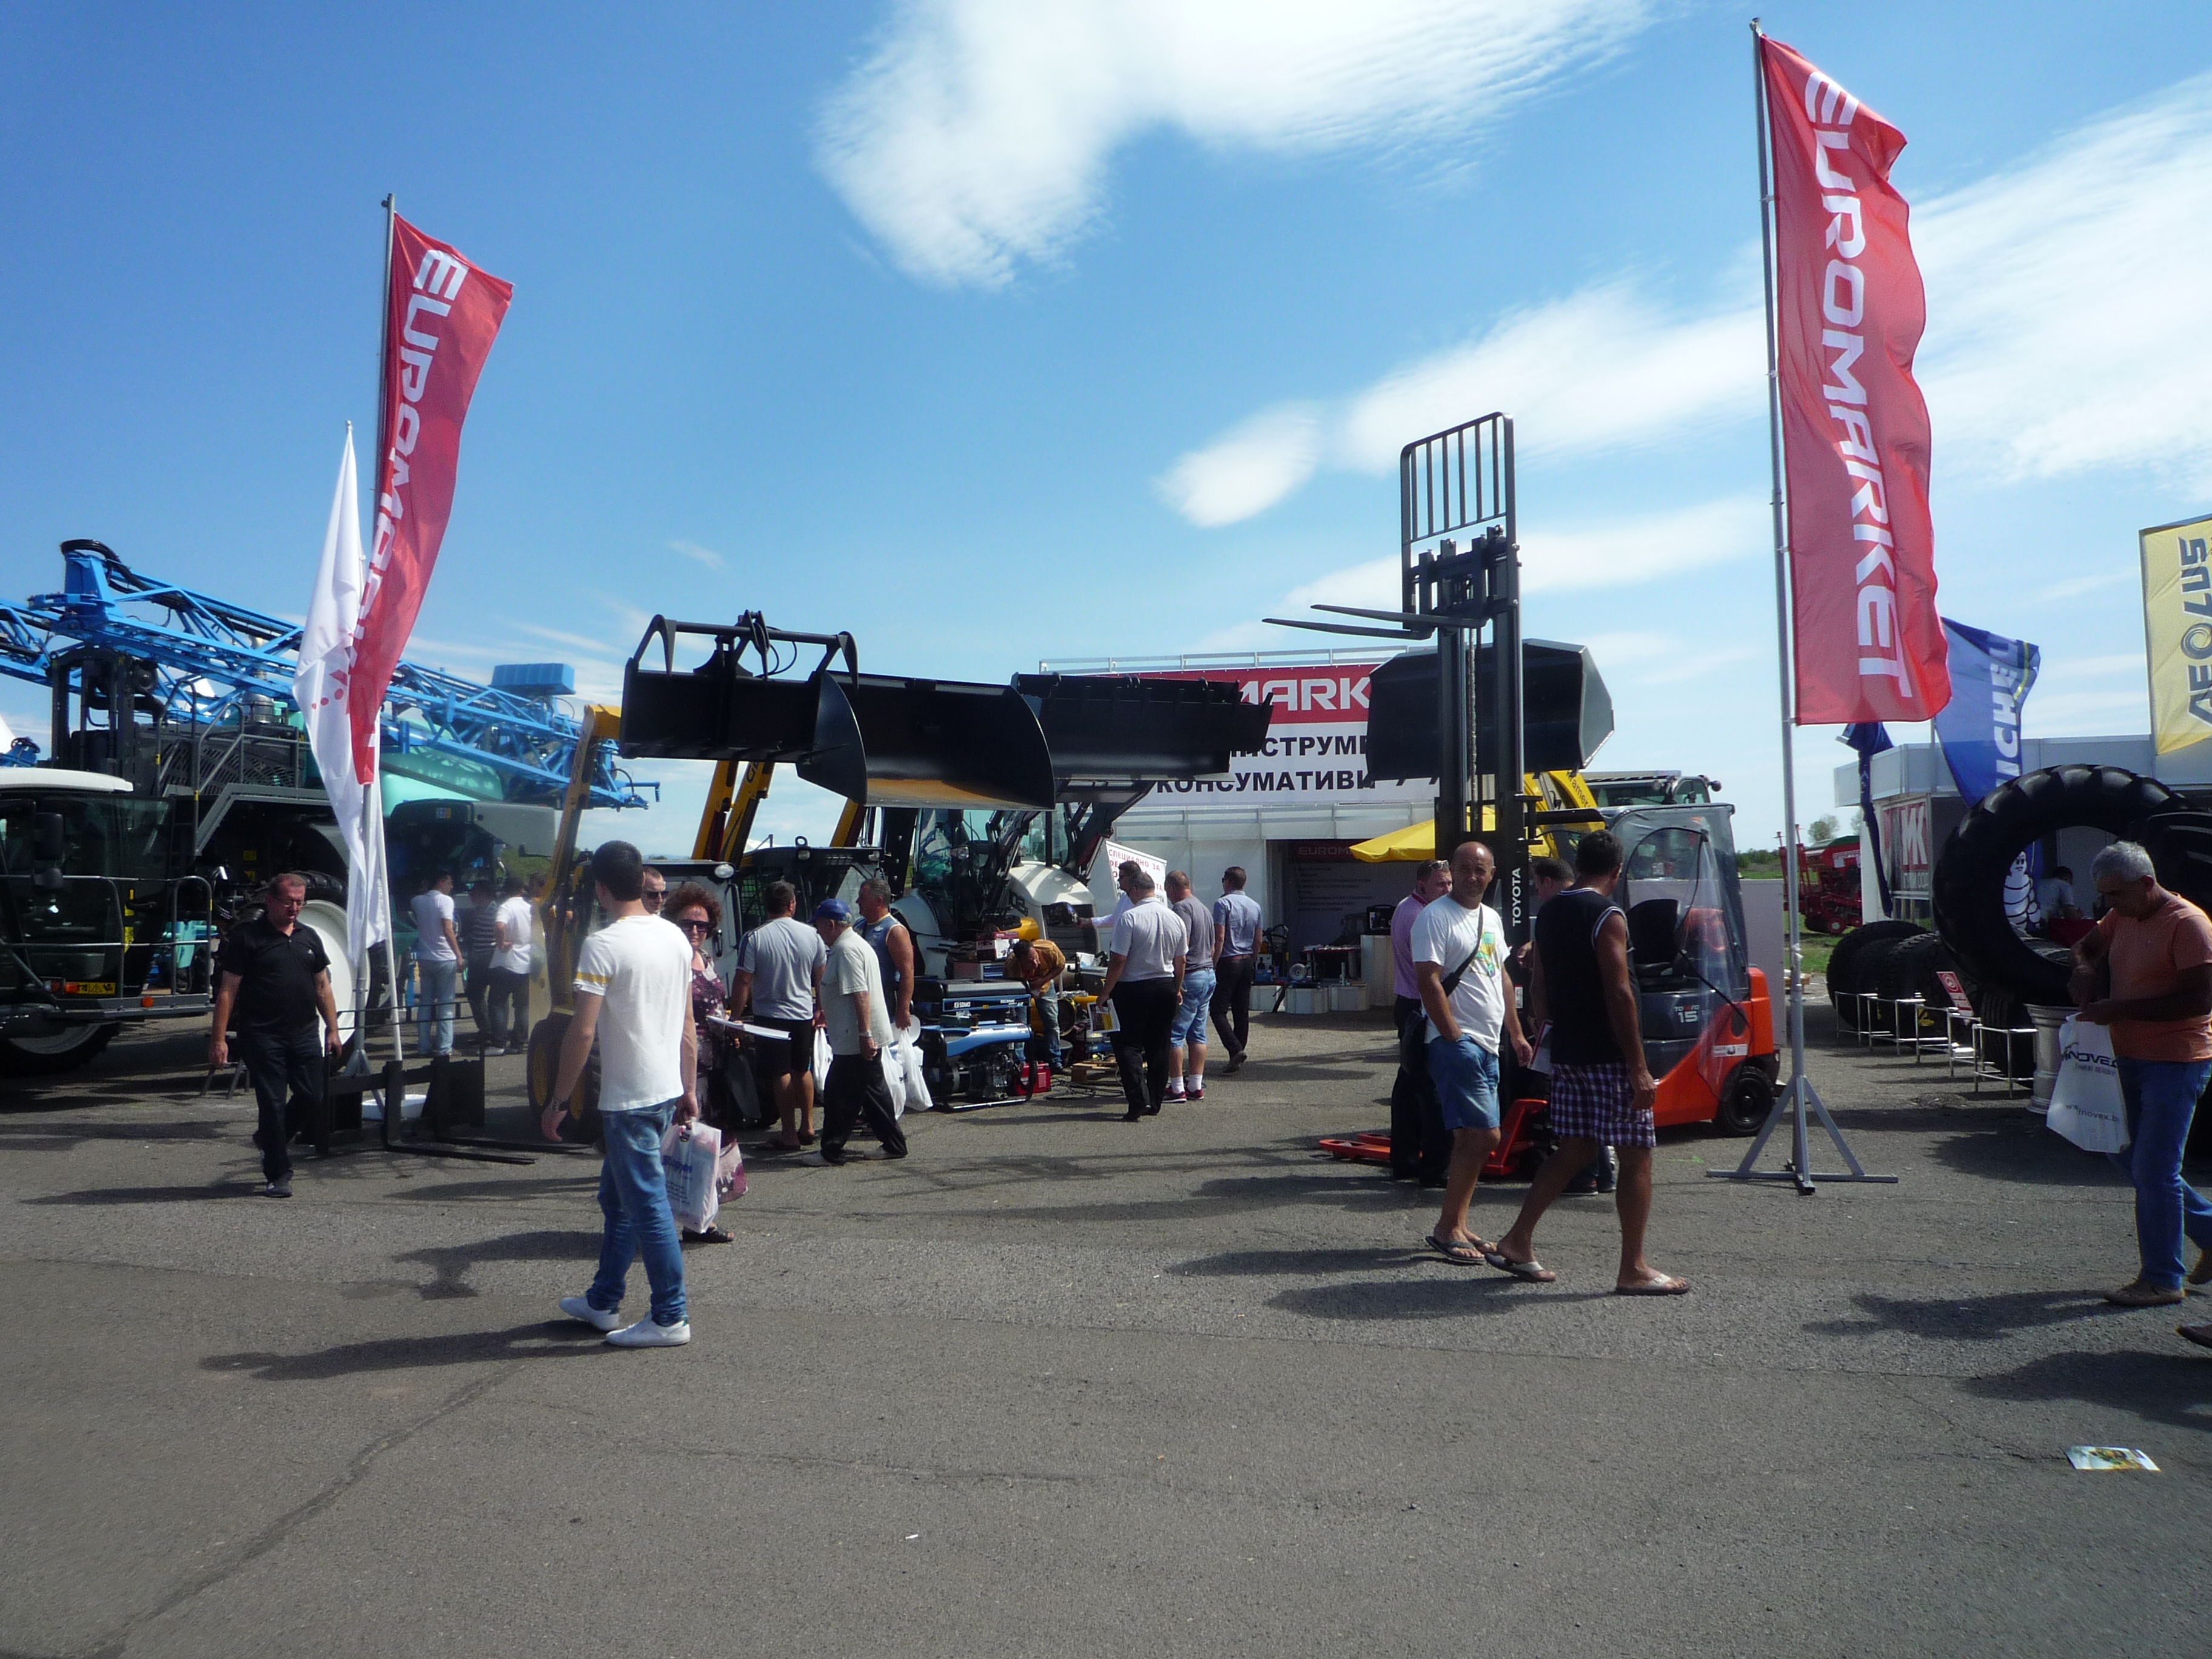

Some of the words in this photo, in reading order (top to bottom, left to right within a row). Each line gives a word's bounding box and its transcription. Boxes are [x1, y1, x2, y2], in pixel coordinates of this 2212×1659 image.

[1804, 70, 1912, 698] EUROMARKET
[1298, 846, 1352, 856] EUROM
[1512, 867, 1521, 927] TOYOTA
[1678, 1010, 1698, 1024] 15
